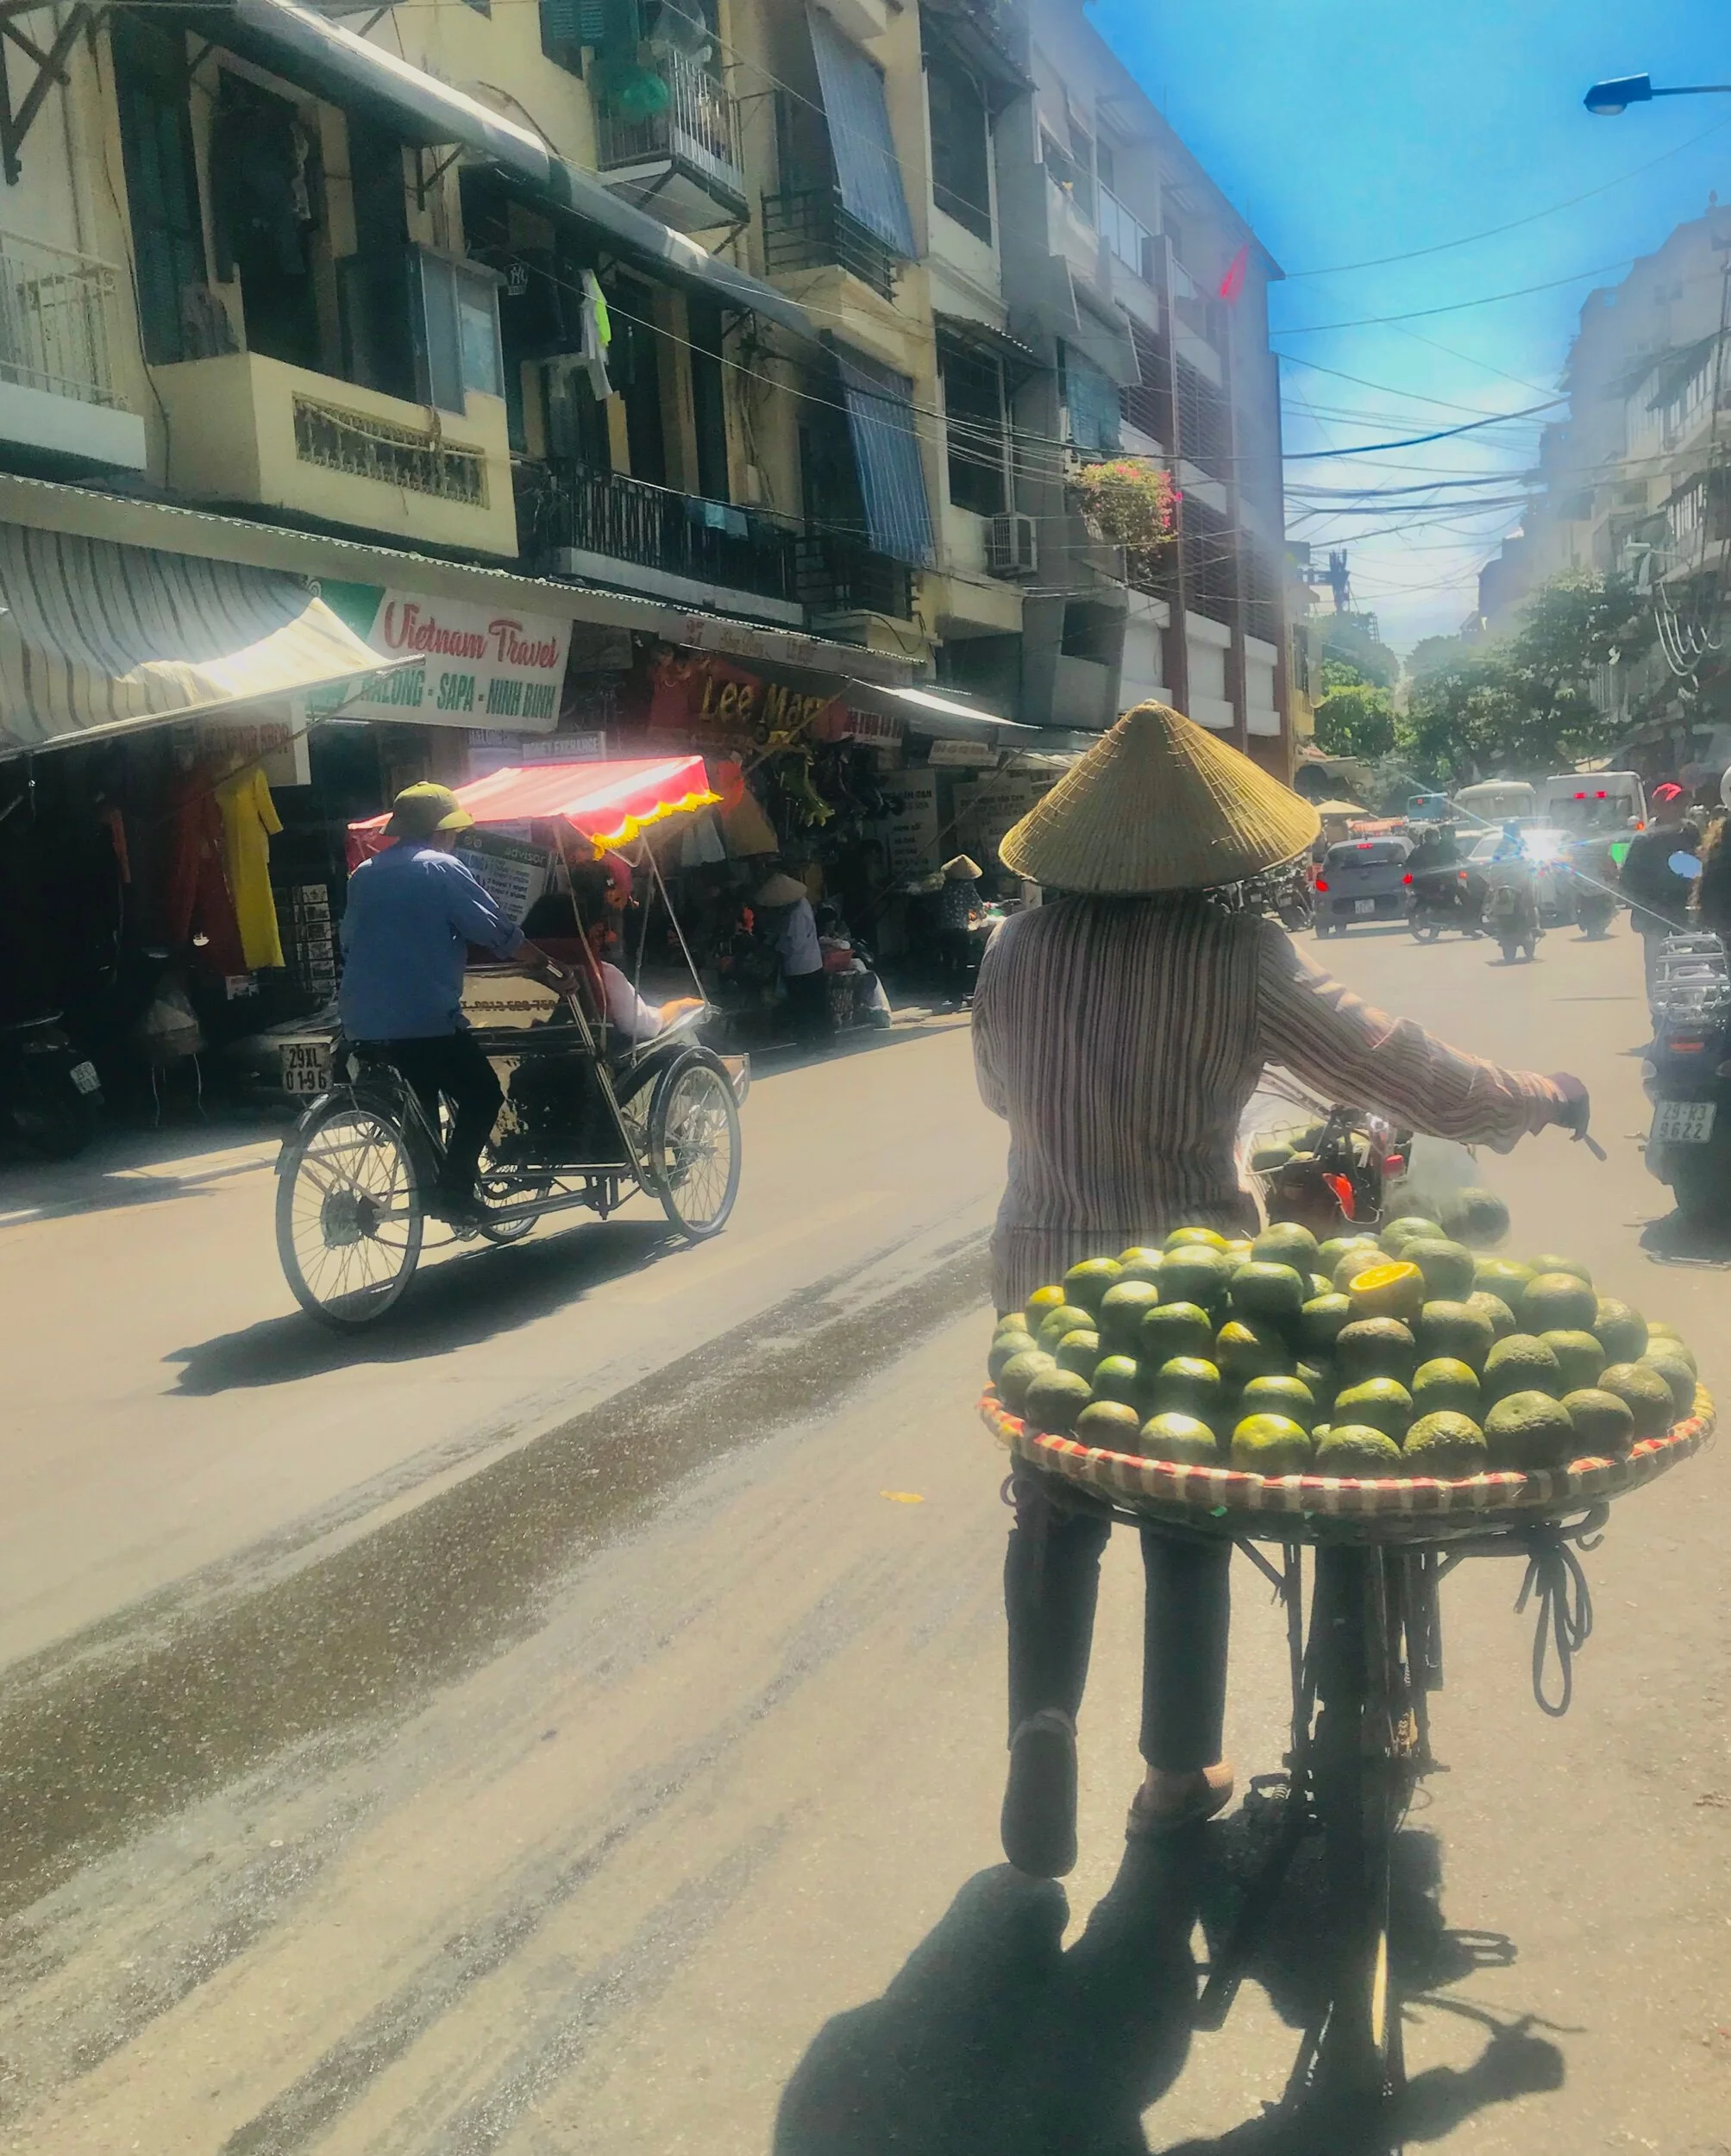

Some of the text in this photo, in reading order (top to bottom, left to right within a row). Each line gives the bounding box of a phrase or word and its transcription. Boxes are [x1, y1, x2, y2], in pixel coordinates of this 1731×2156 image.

[385, 601, 559, 669] Vietnam Travel
[436, 673, 475, 711] SAPA
[486, 678, 522, 717] NINH
[699, 675, 755, 724] Lee
[289, 1047, 323, 1069] 29XL
[1658, 1121, 1705, 1139] 9622
